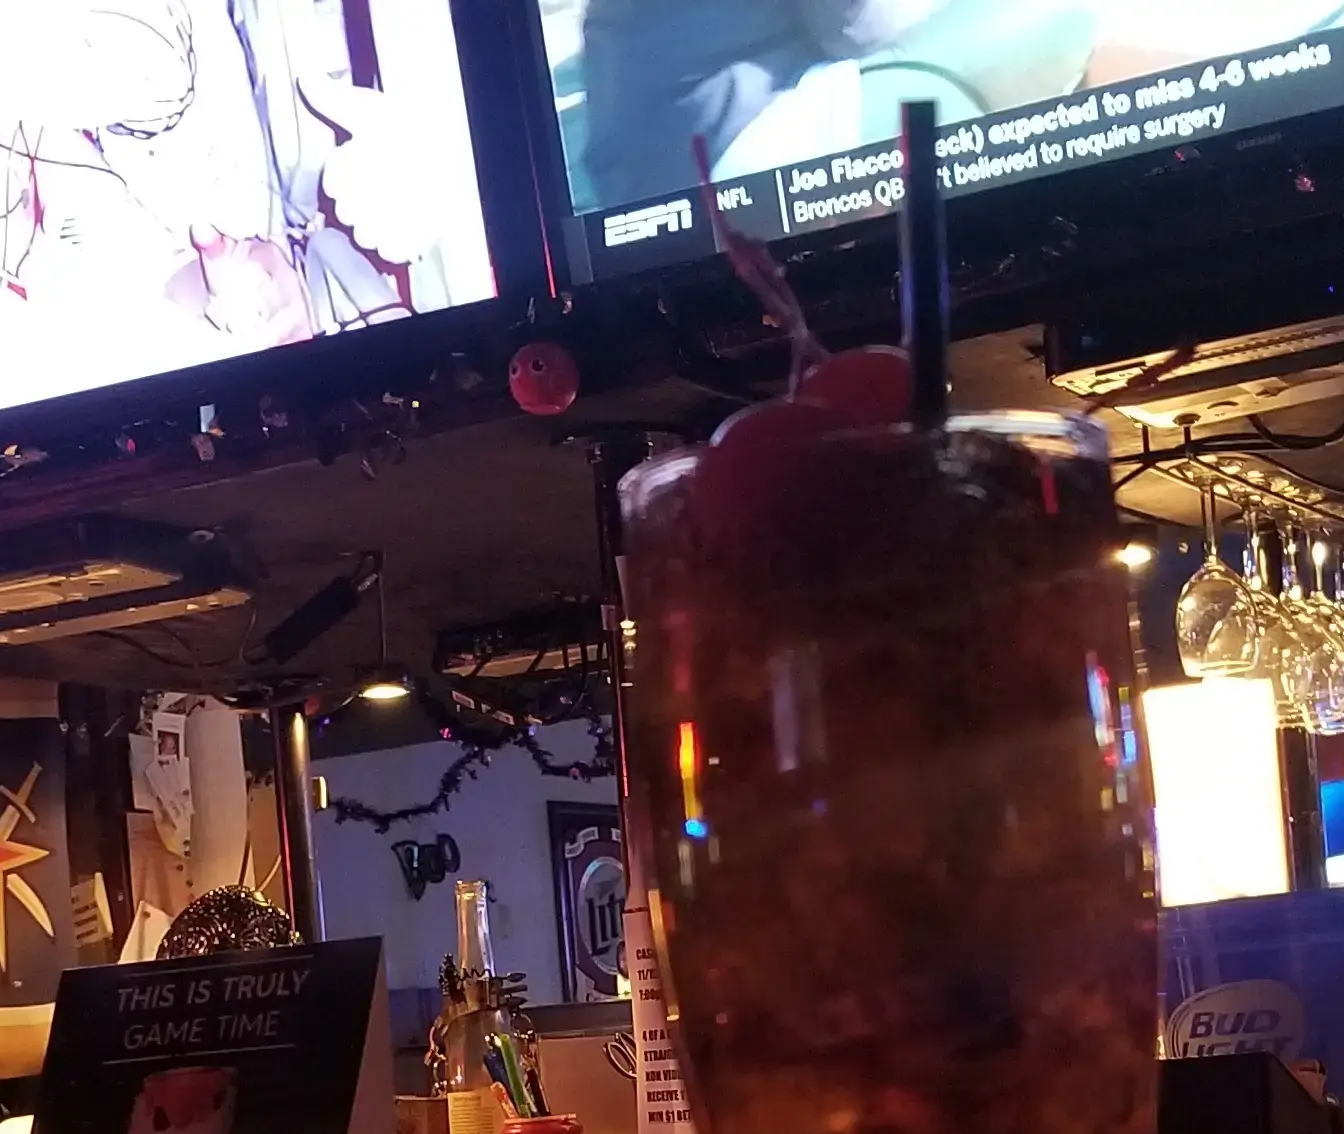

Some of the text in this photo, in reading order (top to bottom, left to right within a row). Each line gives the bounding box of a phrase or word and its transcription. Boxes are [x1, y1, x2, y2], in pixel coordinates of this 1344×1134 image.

[787, 166, 828, 195] Joe
[830, 147, 905, 184] Flacco
[988, 97, 1098, 147] expected
[1101, 92, 1132, 117] to
[1135, 76, 1195, 111] miss
[1198, 59, 1246, 92] 4-6
[1248, 41, 1332, 82] weeks
[793, 189, 873, 224] Broncos
[874, 176, 906, 205] QB
[954, 151, 1038, 186] believed
[1040, 143, 1063, 165] to
[1066, 122, 1141, 161] require
[1143, 102, 1227, 141] surgery
[716, 185, 754, 212] NFL
[603, 198, 694, 248] ESPN
[116, 969, 313, 1014] THIS IS TRULY
[123, 1010, 282, 1051] GAME TIME
[1188, 1009, 1282, 1040] BUD
